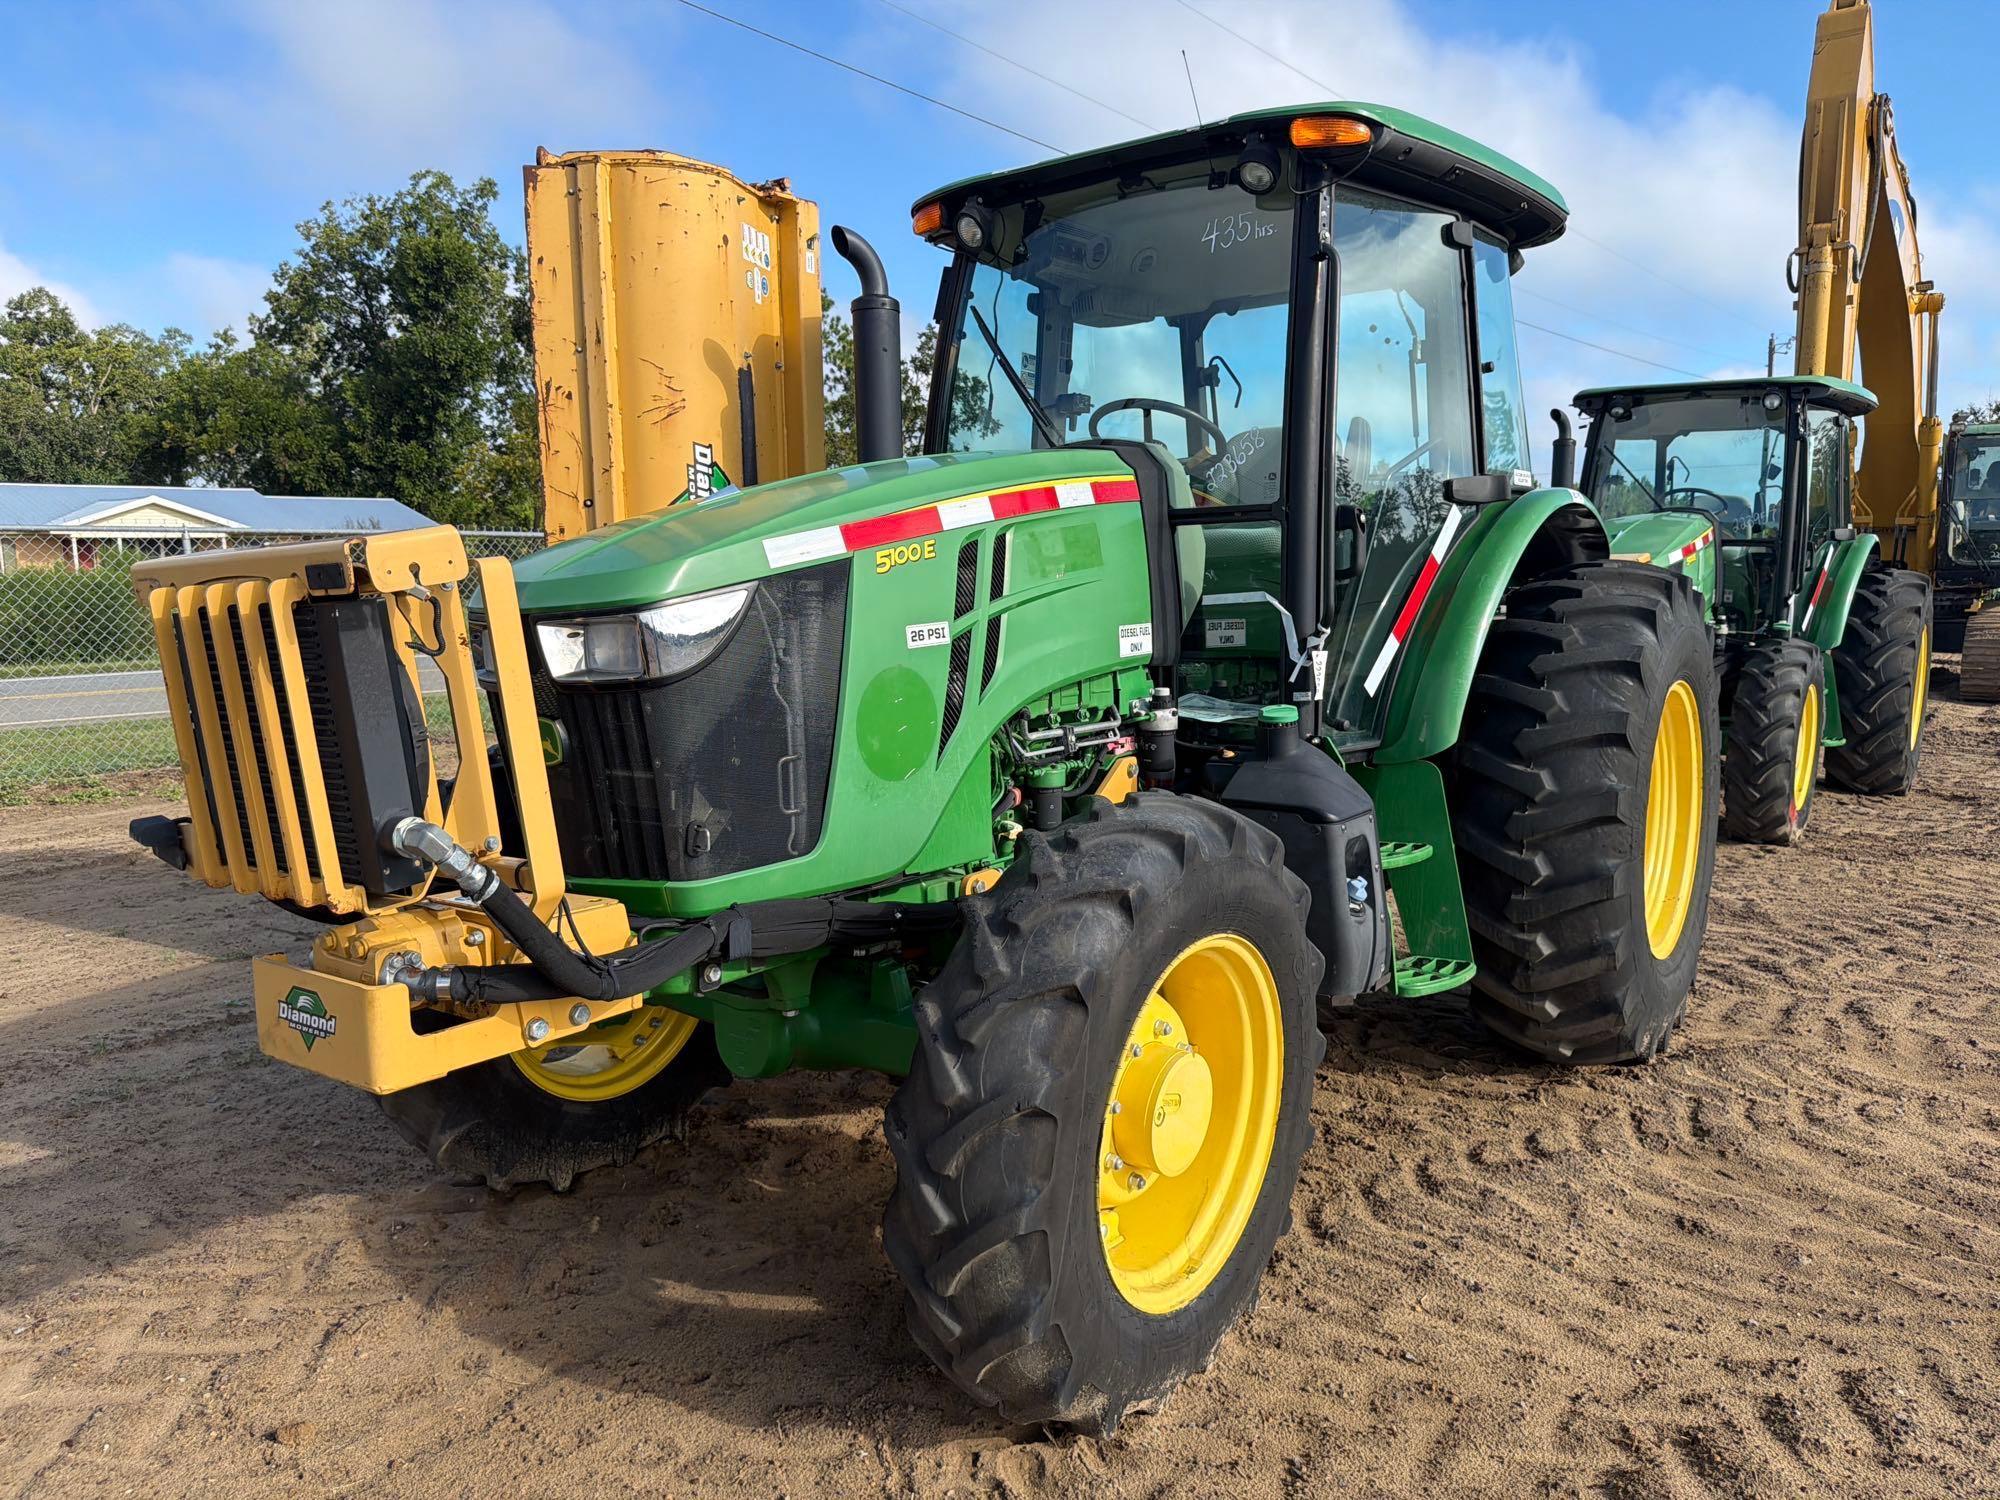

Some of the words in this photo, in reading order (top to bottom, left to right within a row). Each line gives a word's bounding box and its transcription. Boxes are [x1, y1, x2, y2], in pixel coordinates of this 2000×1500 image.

[1201, 211, 1253, 253] 435
[1255, 220, 1278, 239] hrs.
[911, 630, 925, 642] 26
[928, 627, 946, 640] PSI
[1121, 626, 1138, 639] DIESEL
[1140, 626, 1151, 636] FUEL
[1130, 642, 1143, 653] ONLY
[279, 1002, 336, 1034] Diamond
[289, 1022, 325, 1037] MOWERS
